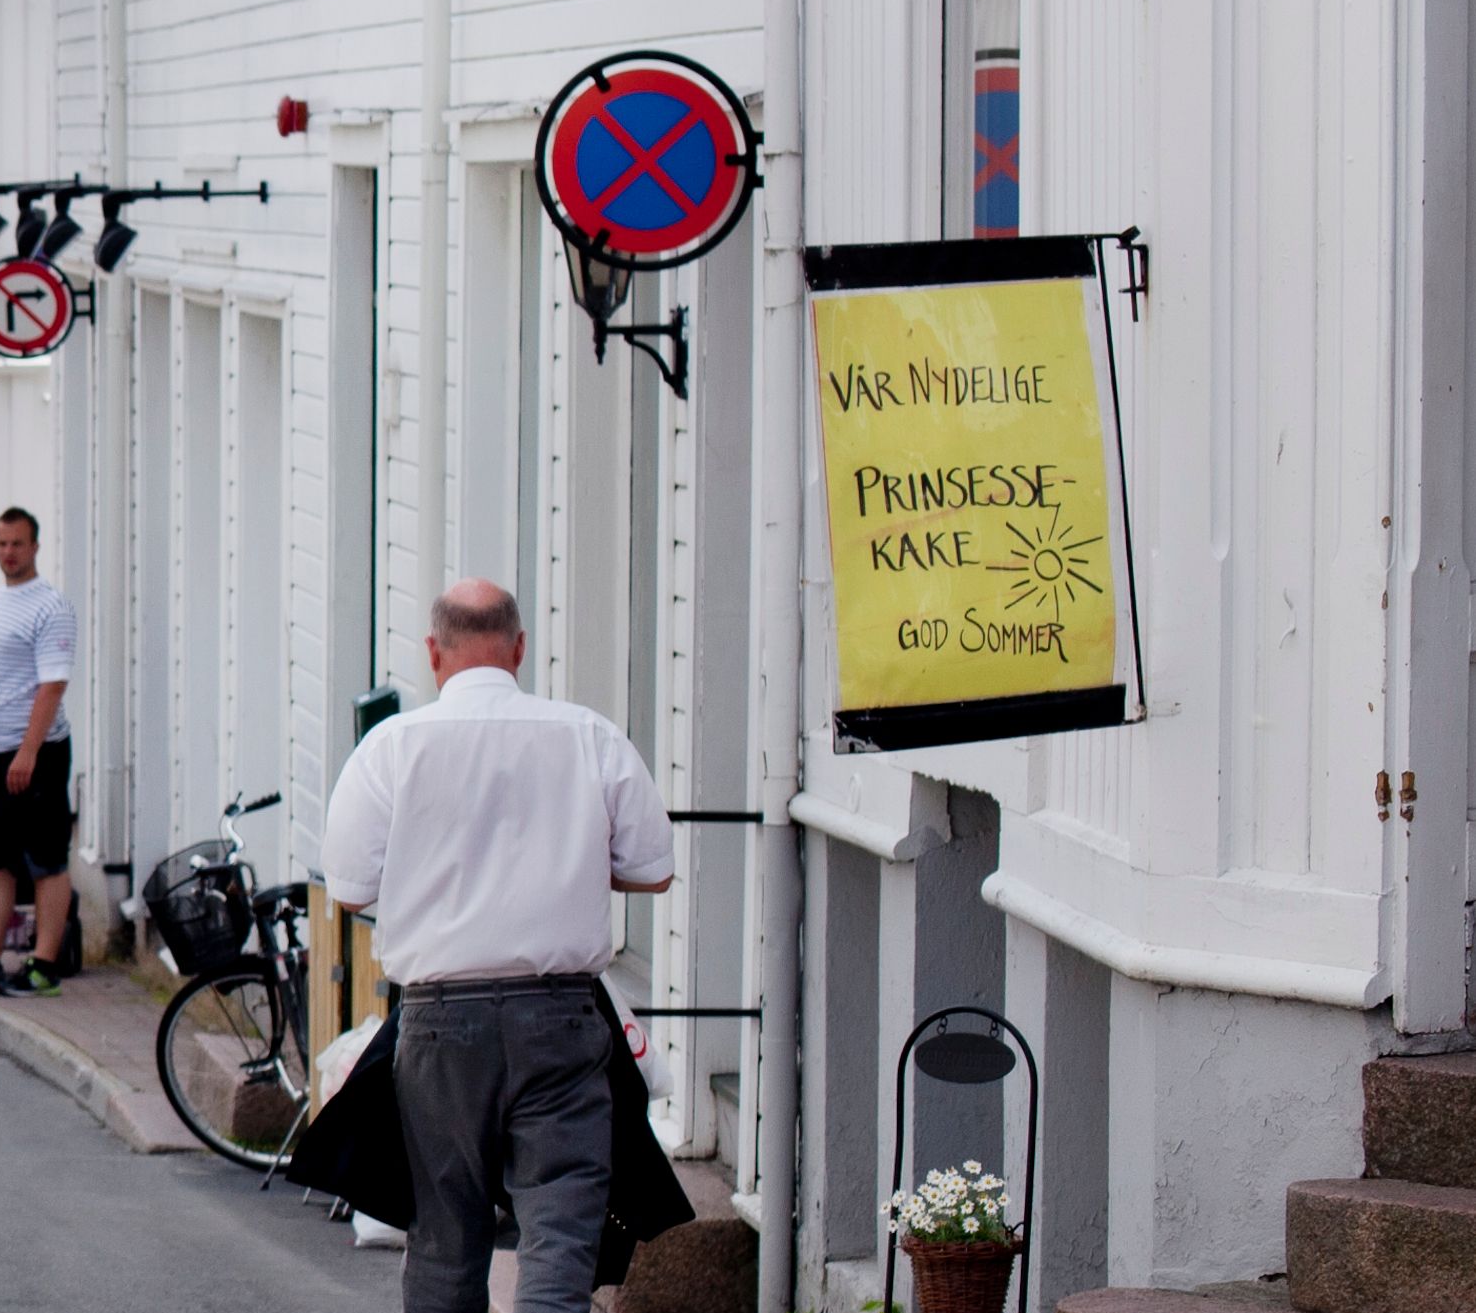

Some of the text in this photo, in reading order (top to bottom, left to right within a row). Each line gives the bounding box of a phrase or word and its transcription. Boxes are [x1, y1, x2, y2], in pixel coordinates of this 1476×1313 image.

[829, 356, 1052, 412] VÅR NYDELIGE
[854, 464, 1077, 517] PRINSESSE-
[870, 531, 982, 572] KAKE
[898, 607, 1069, 663] GOD SOMMER
